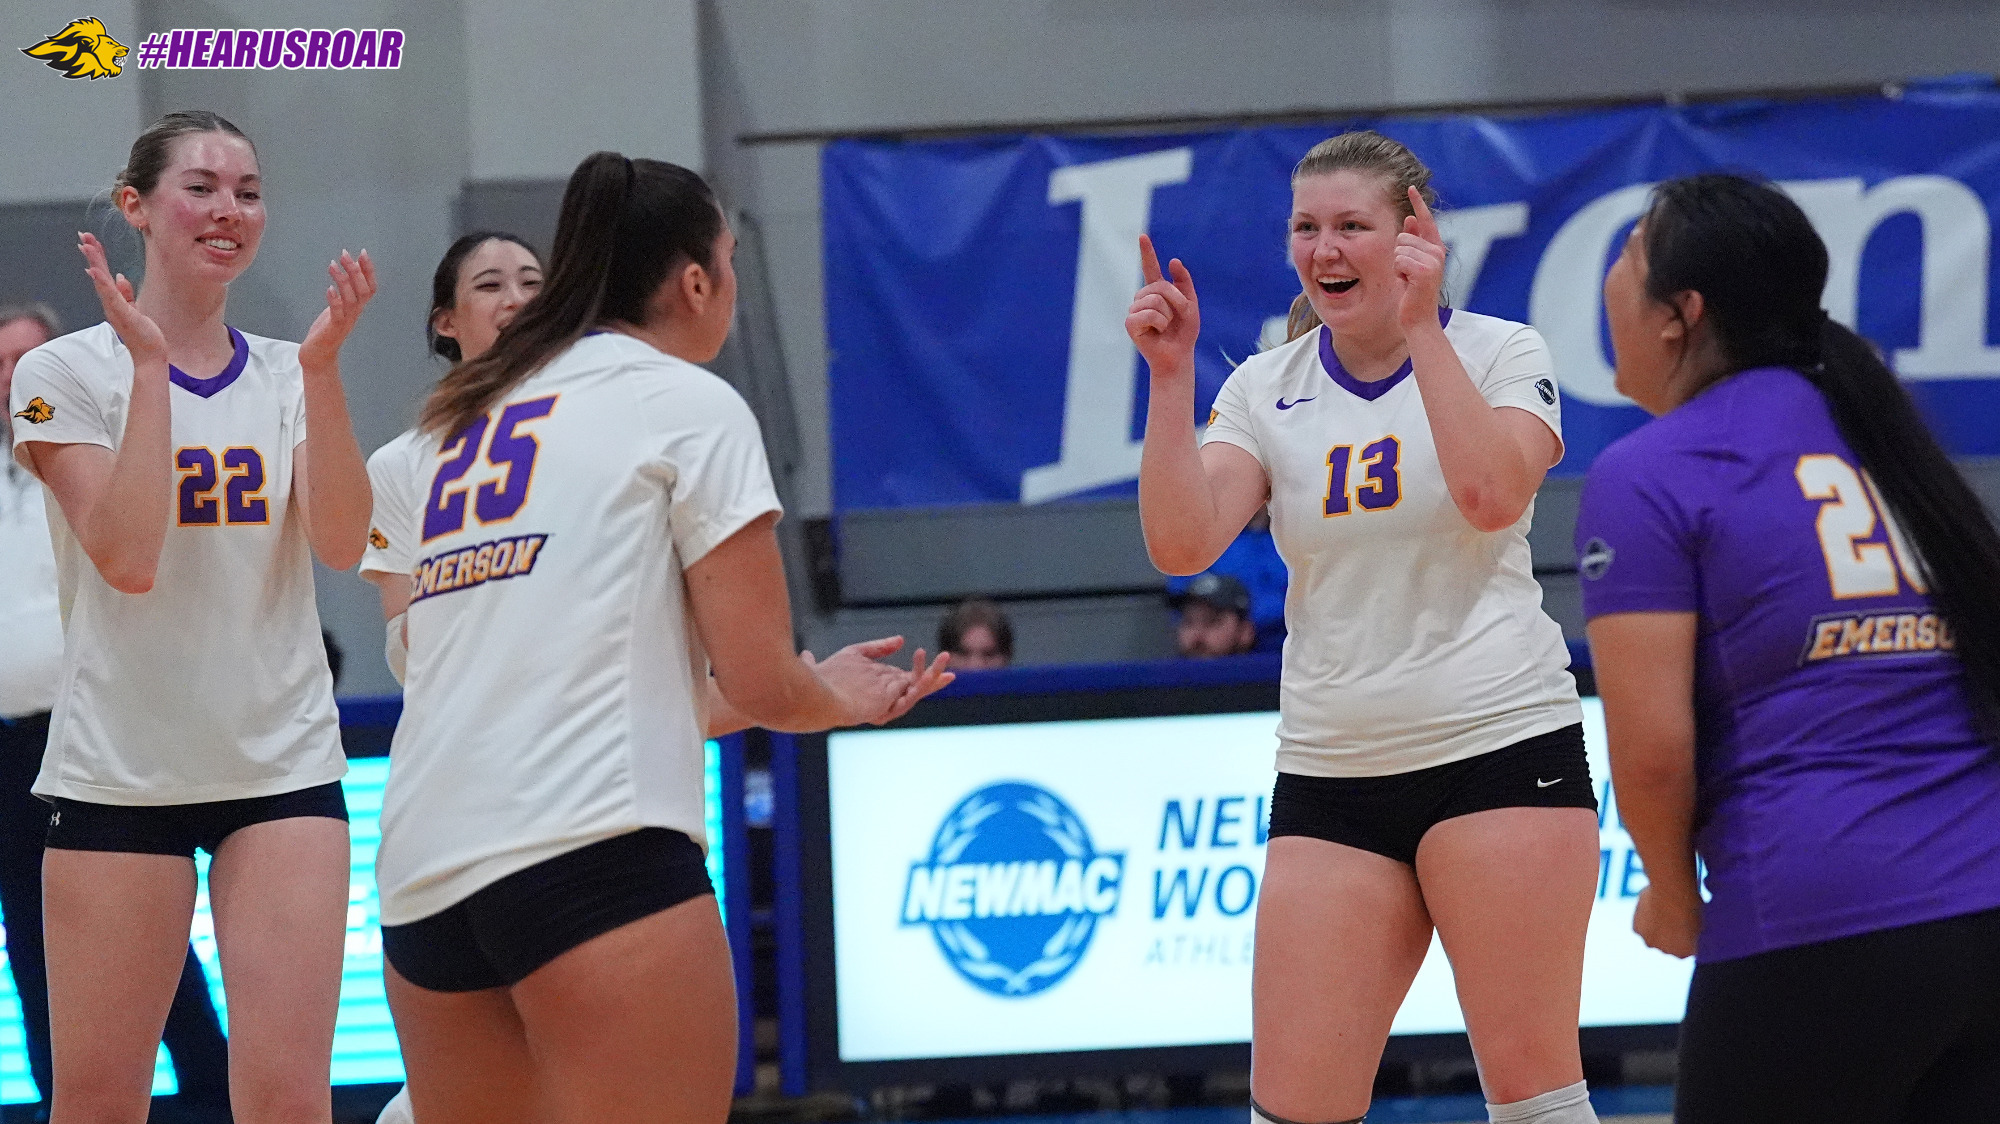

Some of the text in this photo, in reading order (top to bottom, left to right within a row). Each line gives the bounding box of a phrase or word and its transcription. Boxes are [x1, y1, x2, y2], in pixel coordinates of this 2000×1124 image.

[175, 445, 271, 527] 22
[420, 393, 561, 546] 25
[1323, 434, 1403, 519] 13
[903, 856, 1122, 923] NEWMAC
